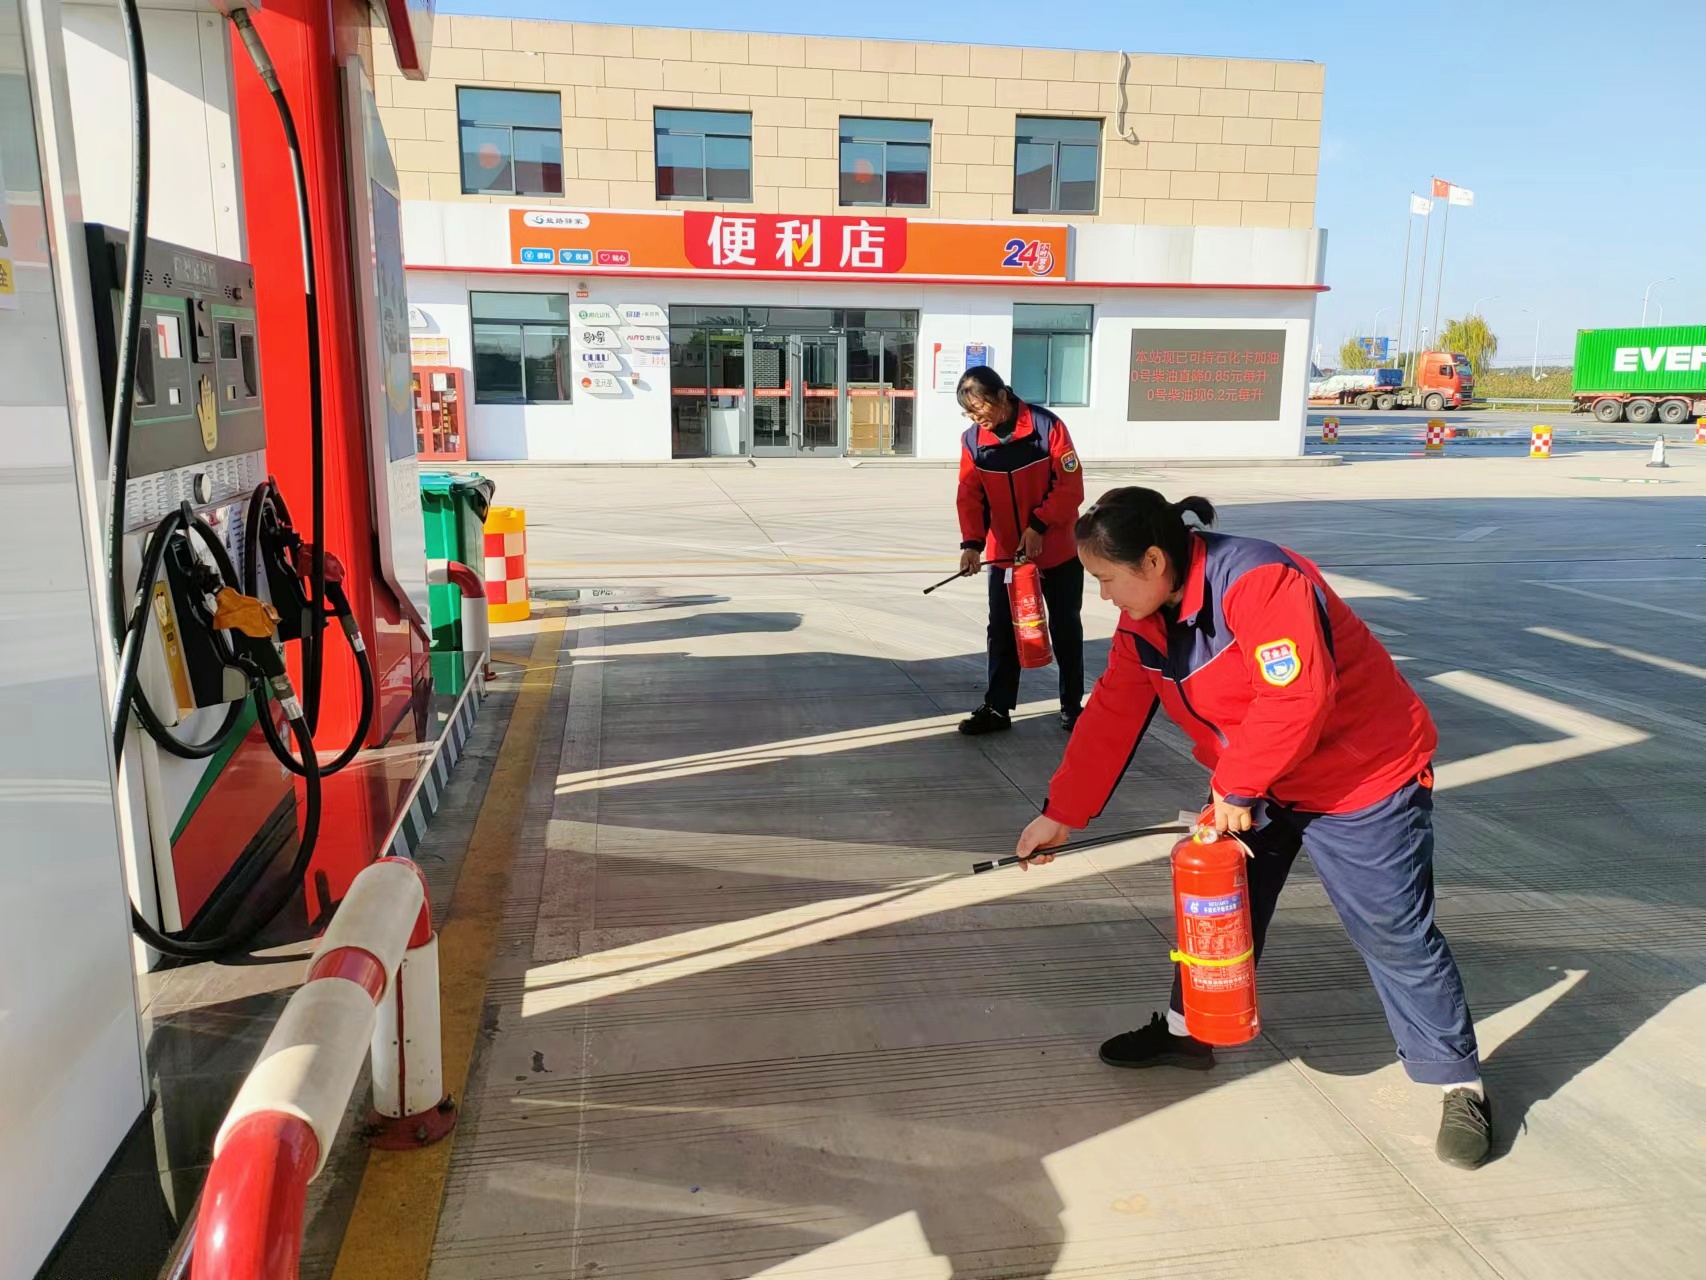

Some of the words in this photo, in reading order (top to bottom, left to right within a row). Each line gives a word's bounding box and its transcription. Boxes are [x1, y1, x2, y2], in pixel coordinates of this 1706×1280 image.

[707, 215, 886, 268] 便利店
[1002, 238, 1040, 267] 24
[1135, 350, 1280, 364] 本站现已可持石化卡加油
[1147, 388, 1264, 402] 0号柴油现6.2元每升
